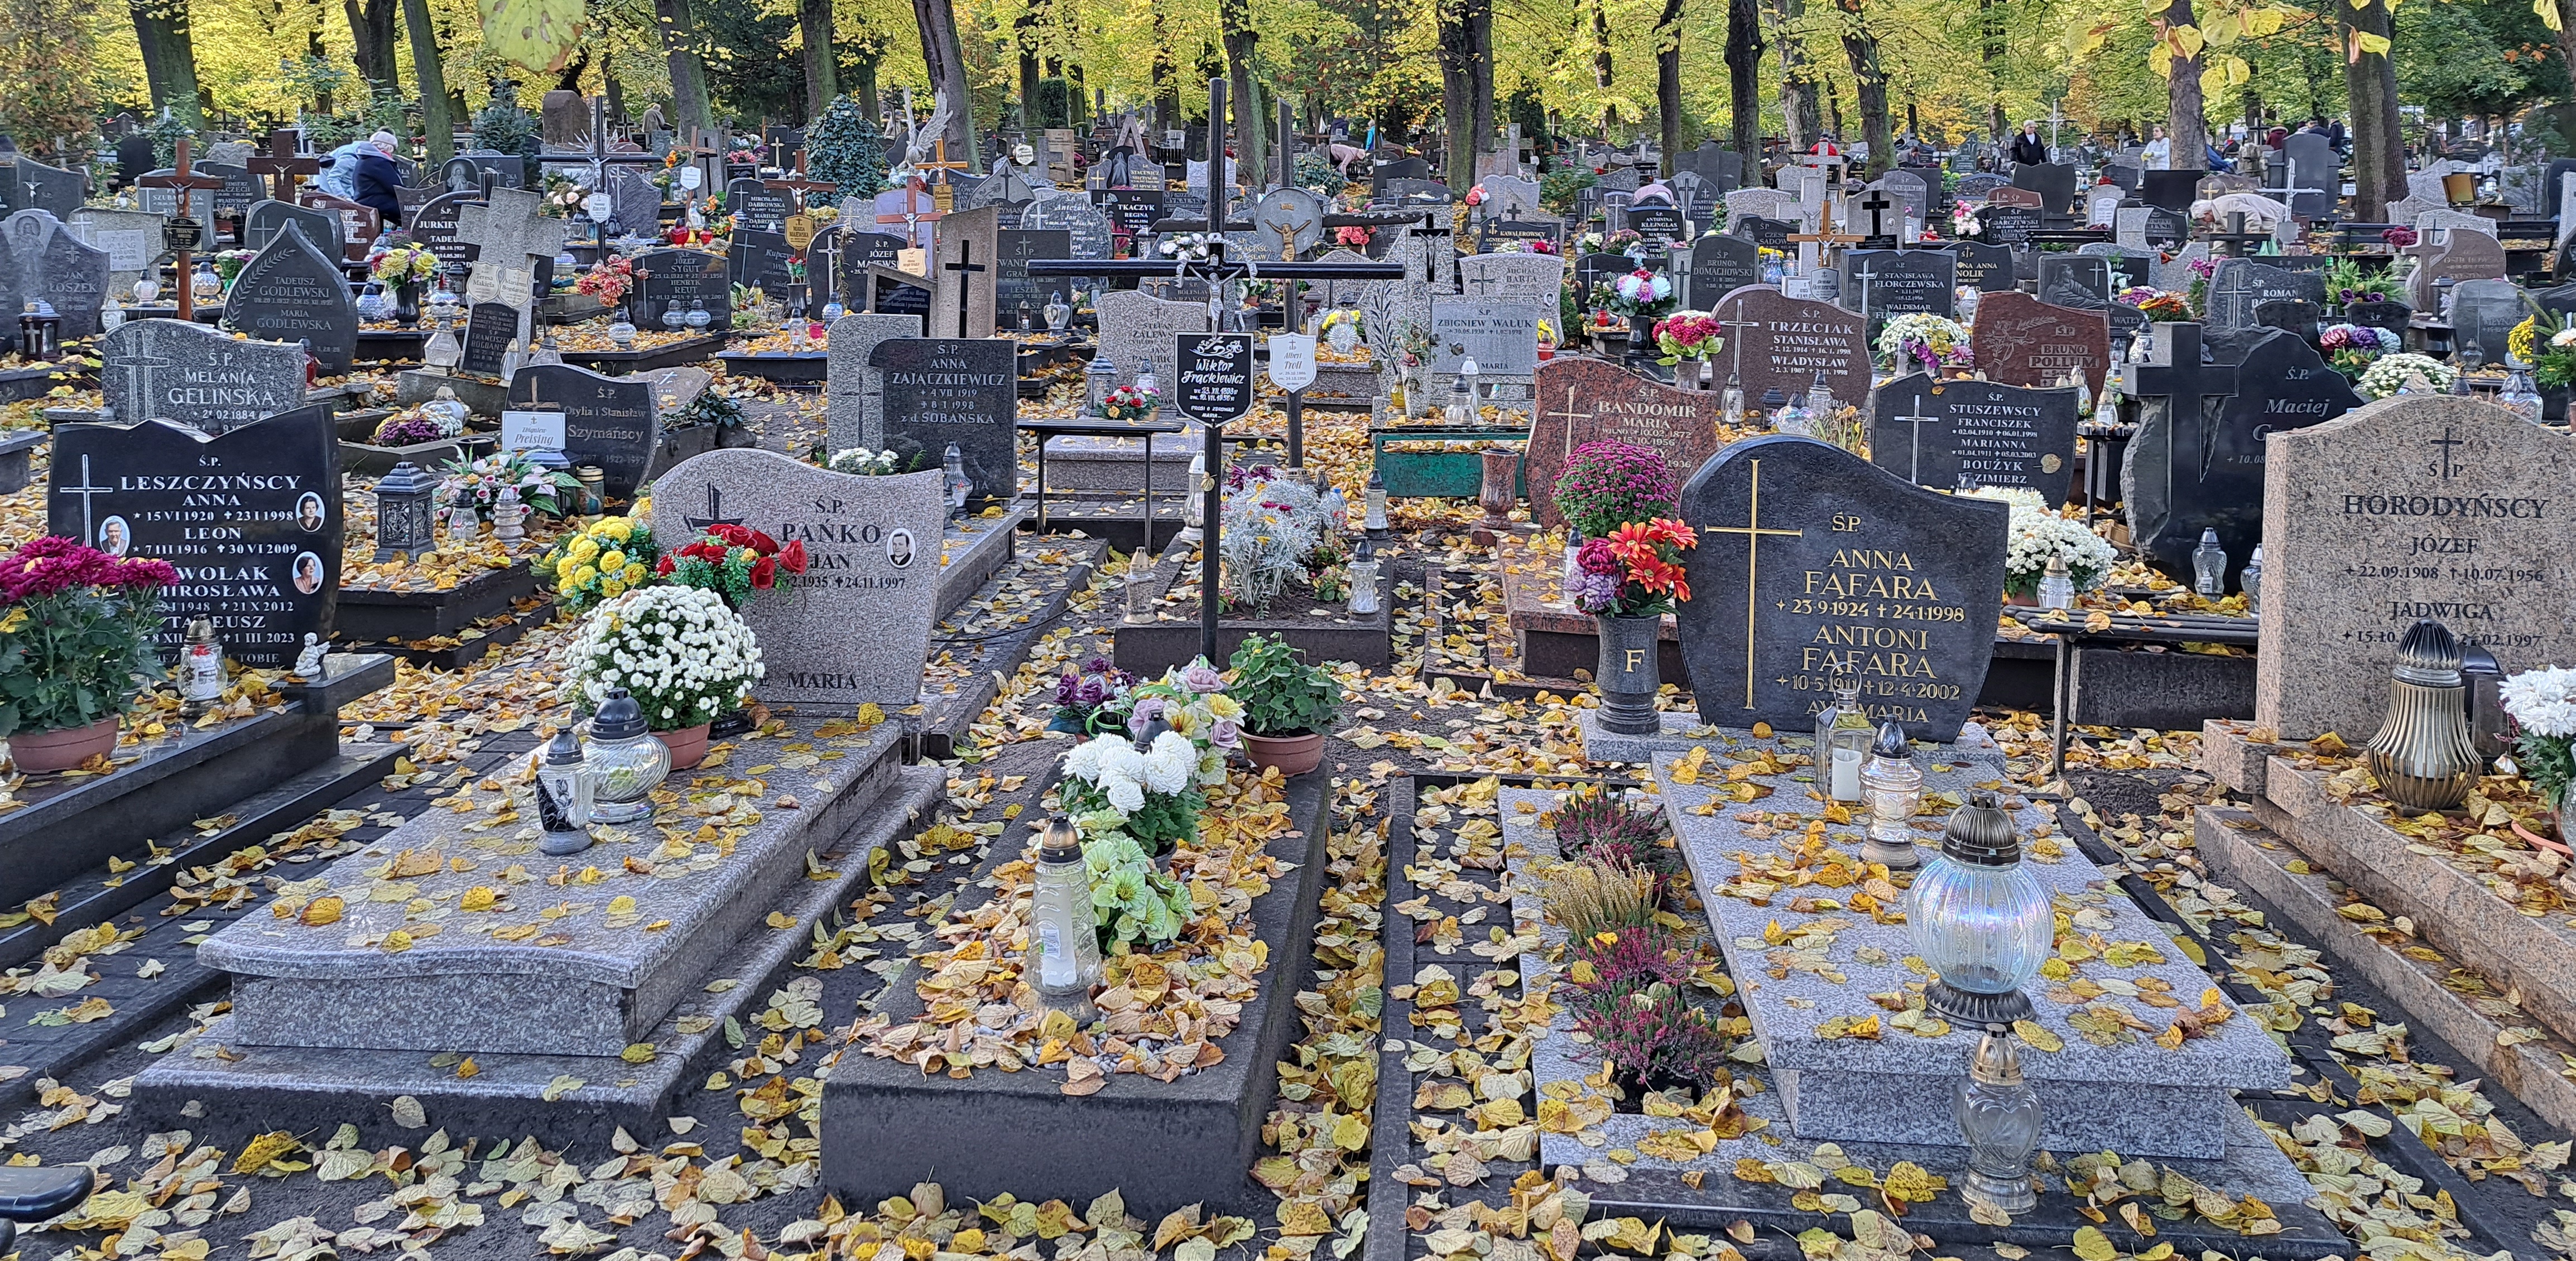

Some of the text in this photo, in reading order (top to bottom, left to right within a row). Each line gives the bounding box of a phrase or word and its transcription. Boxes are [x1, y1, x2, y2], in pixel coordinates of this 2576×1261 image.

[1117, 203, 1155, 211] TKACZYK
[63, 271, 84, 280] JAN
[1693, 267, 1753, 277] DOMACHOWSKI
[1885, 272, 1935, 280] STANISŁAWA
[275, 276, 315, 285] TADEUSZ
[1875, 280, 1945, 289] FLORCZEWSKA
[49, 283, 98, 293] ŁOSZEK
[259, 286, 329, 298] GODLEWSKI
[2263, 288, 2299, 297] ROMAN
[281, 309, 309, 317] MARIA
[257, 318, 332, 330] GODLEWSKA
[1492, 320, 1533, 329] WALUK
[1768, 321, 1854, 335] TRZECIAK
[1774, 335, 1848, 347] STANISŁAWA
[2043, 345, 2085, 354] BRUNO
[930, 358, 968, 369] ANNA
[1196, 359, 1234, 372] Wiktor
[1771, 355, 1849, 368] WŁADYSŁAW
[185, 370, 257, 384] MELANIA
[892, 373, 1005, 386] ZAJĄCZKIEWICZ
[1181, 370, 1246, 384] Frąckiewicz
[168, 386, 277, 406] GELIŃSKA
[930, 389, 937, 397] 4
[958, 388, 978, 398] 1919
[952, 401, 974, 410] 1998
[1598, 400, 1697, 418] BANDOMIR
[1949, 403, 2042, 417] STUSZEWSCY
[2263, 398, 2331, 417] Maciej
[921, 412, 996, 424] SOBAŃSKA
[1623, 417, 1671, 430] MARIA
[1958, 418, 2032, 429] FRANCISZEK
[514, 434, 554, 445] Preising
[568, 425, 644, 442] Szymańscy
[1960, 439, 2027, 450] MARIANNA
[1962, 458, 2023, 472] BOUŻYK
[121, 472, 301, 490] LESZCZYŃSCY
[1958, 473, 2027, 484] KZIMIERZ
[182, 494, 242, 507] ANNA
[815, 495, 846, 514] Ś.P.
[2343, 493, 2549, 519] HORODYŃSCY
[147, 511, 161, 522] 15
[164, 511, 180, 522] VI
[185, 511, 214, 522] 1920
[236, 511, 251, 521] 23
[263, 511, 294, 521] 1998
[184, 527, 242, 540] LEON
[782, 519, 881, 543] PAŃKO
[145, 543, 297, 555] 7 III 1916 30 VI 2009
[2409, 533, 2479, 556] JÓZEF
[810, 554, 852, 569] JAN
[1828, 548, 1915, 571] ANNA
[175, 566, 271, 580] WOLAK
[2358, 566, 2544, 583] 22.09.1908 10.07.1956
[846, 577, 906, 589] 24.11.1997
[181, 601, 294, 612] 1948 21 X 2012
[2388, 600, 2495, 620] JADWIGA
[169, 615, 266, 629] TAEUSZ
[246, 633, 261, 642] III
[267, 633, 295, 642] 2023
[1811, 625, 1929, 651] ANTONI
[240, 653, 280, 663] TOBIE
[1625, 649, 1645, 673] F
[787, 673, 857, 689] MARIA
[1857, 703, 1930, 723] MARIA
